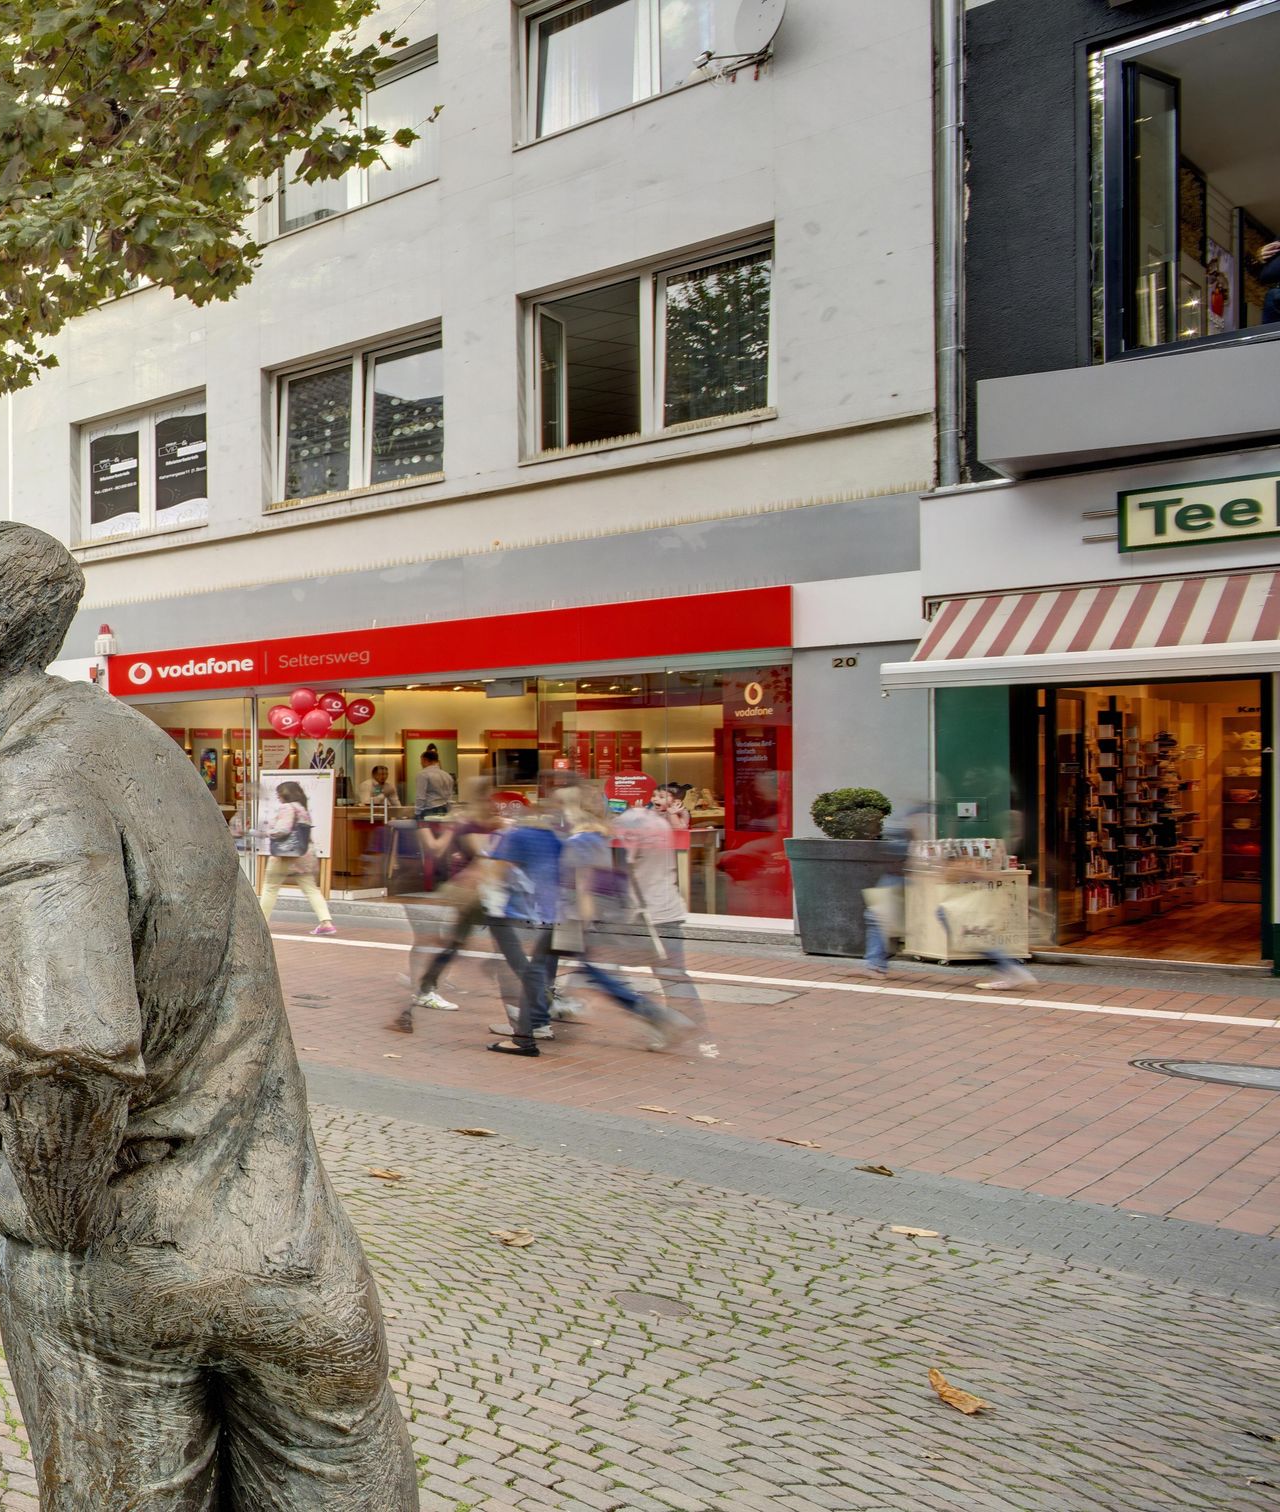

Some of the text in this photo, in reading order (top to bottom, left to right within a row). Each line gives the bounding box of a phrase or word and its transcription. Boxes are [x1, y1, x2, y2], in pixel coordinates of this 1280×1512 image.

[1138, 497, 1263, 536] Tee
[157, 650, 371, 679] vodafone Seltersweg
[833, 657, 857, 668] 20
[734, 706, 774, 718] vodafone
